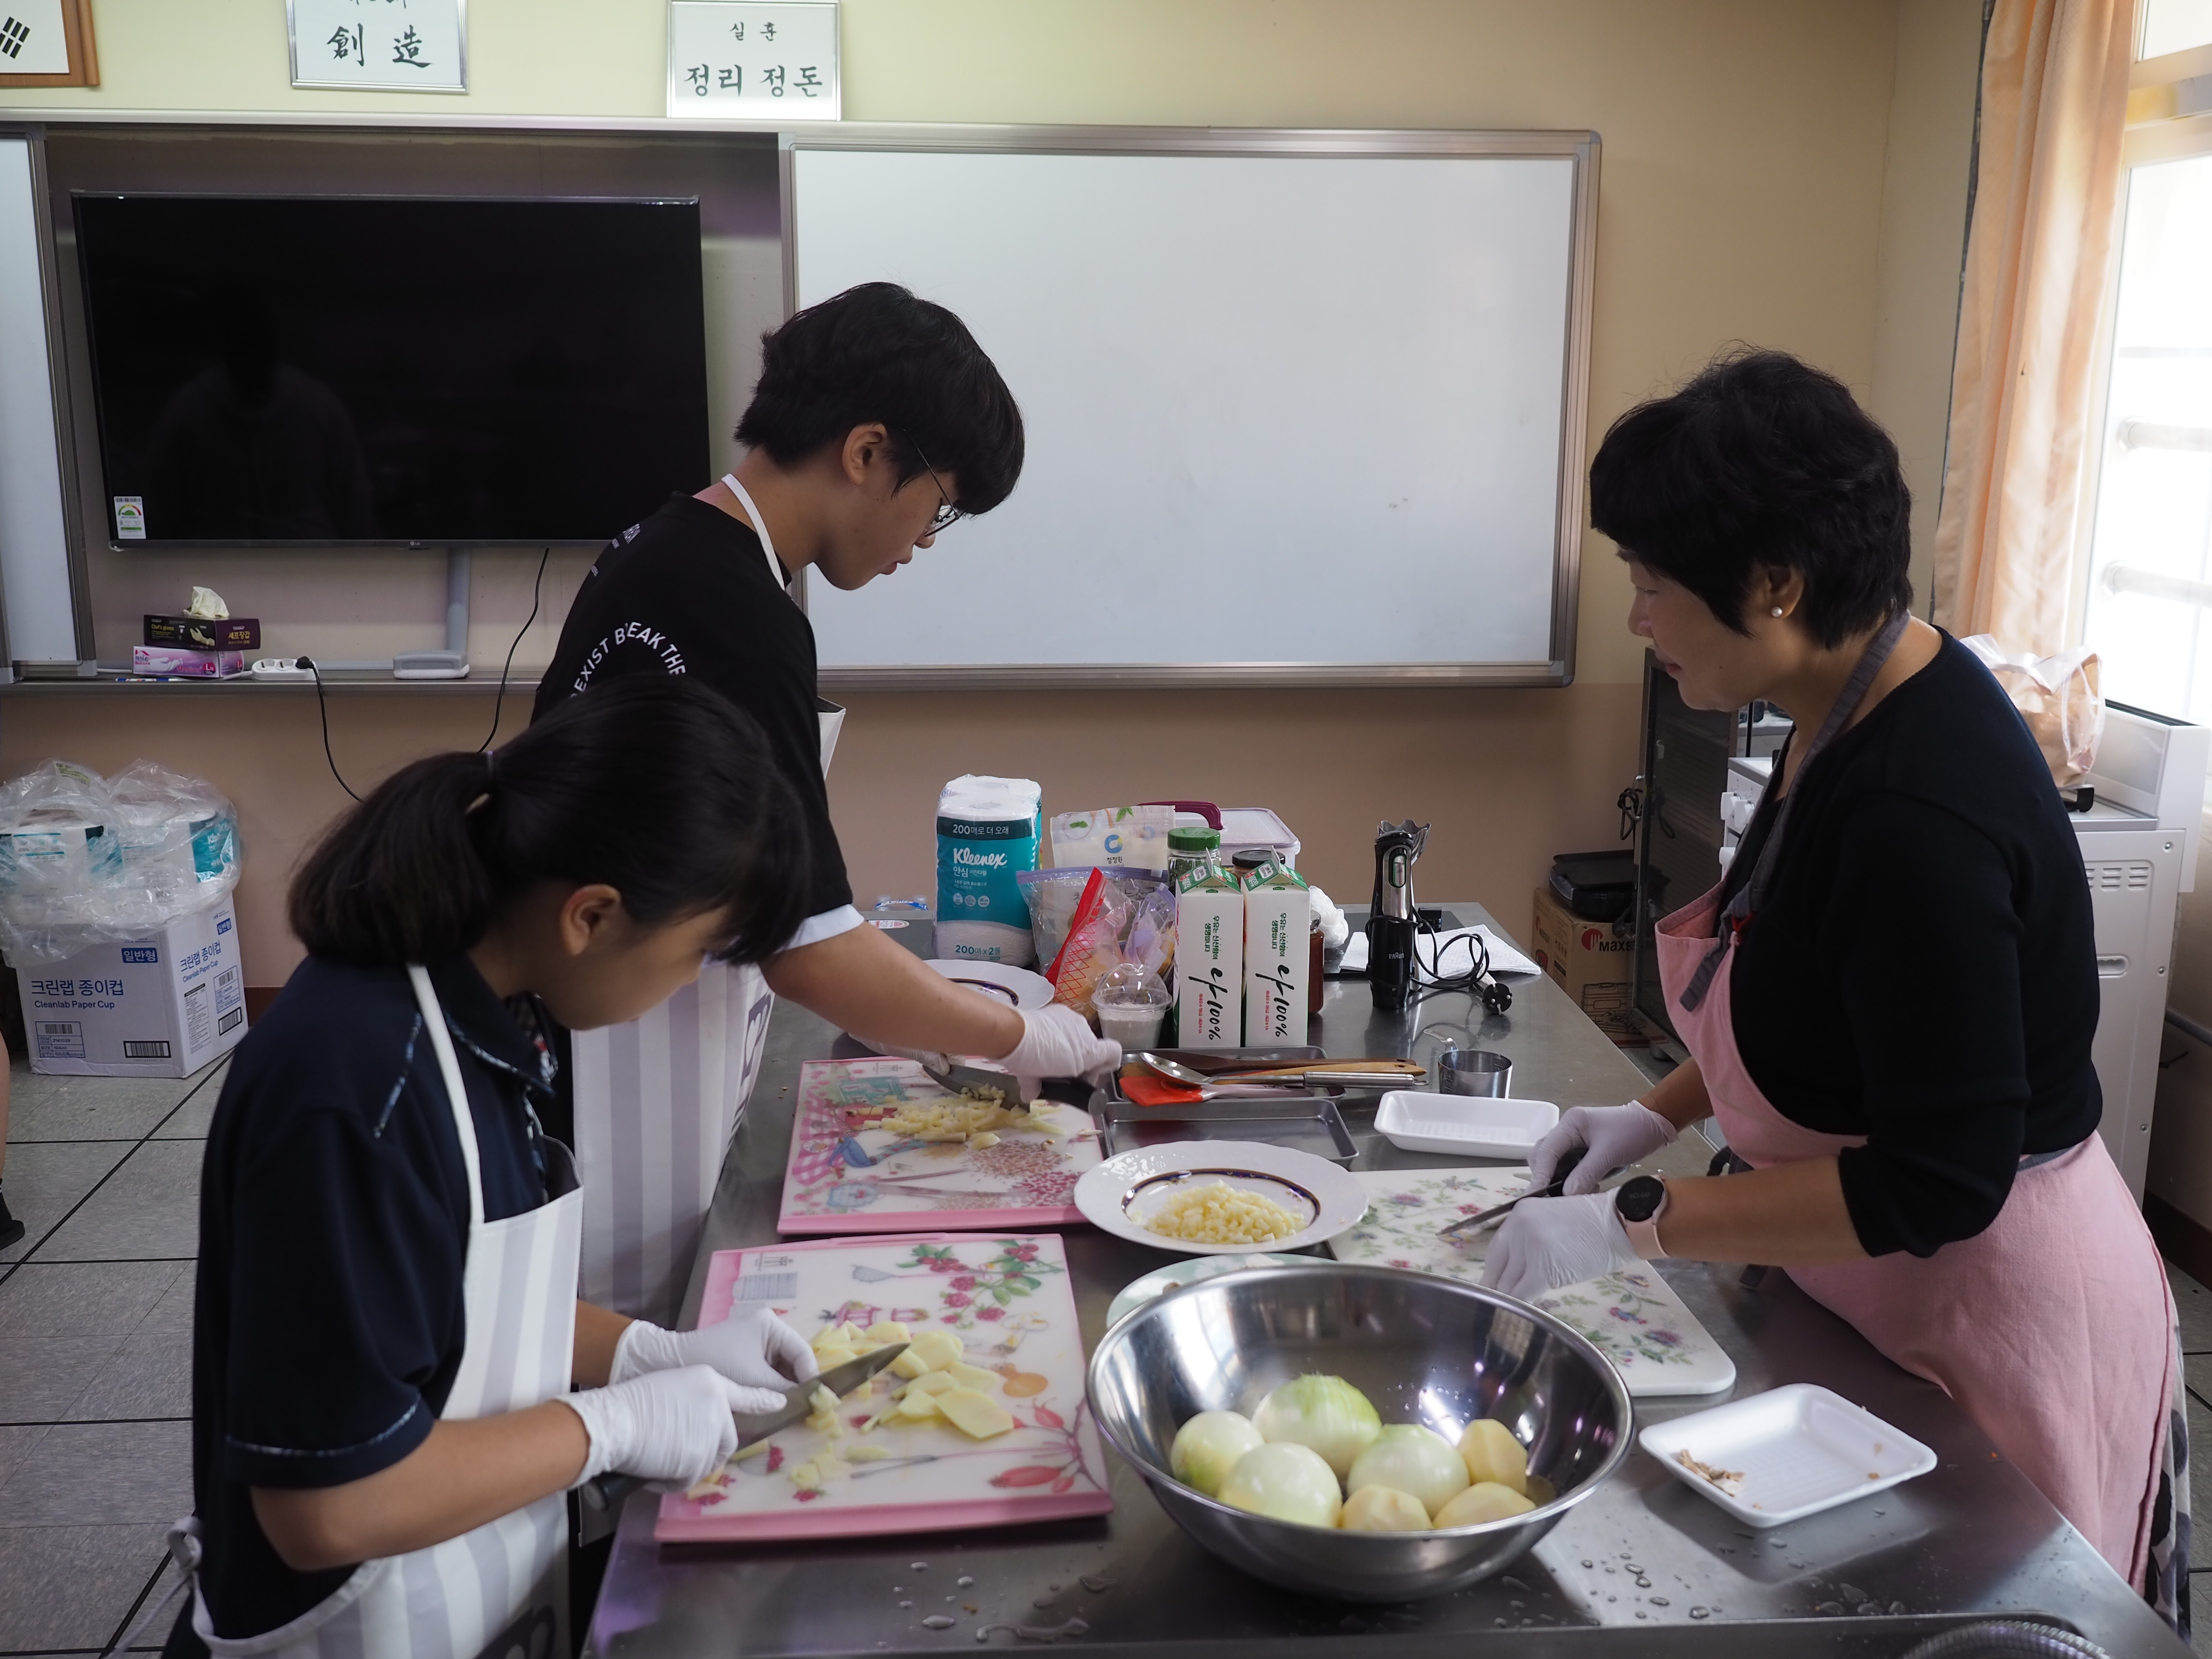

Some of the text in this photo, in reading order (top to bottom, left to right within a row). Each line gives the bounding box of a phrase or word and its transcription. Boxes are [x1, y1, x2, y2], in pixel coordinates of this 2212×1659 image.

[326, 23, 434, 68] 創造
[684, 63, 823, 97] 정리 정돈
[952, 824, 1009, 835] 200매로 더 오래
[953, 847, 1008, 869] Kleenex
[1106, 856, 1123, 864] 청정원
[953, 866, 968, 878] 안심
[217, 920, 231, 934] 일반형
[123, 950, 156, 962] 일반형
[180, 940, 221, 972] 크린랩 종이컵
[183, 970, 199, 982] Cleanlab
[200, 964, 211, 974] Paper
[31, 979, 124, 996] 크린랩 종이컵
[72, 1000, 96, 1009] Paper
[97, 1000, 115, 1010] Cup
